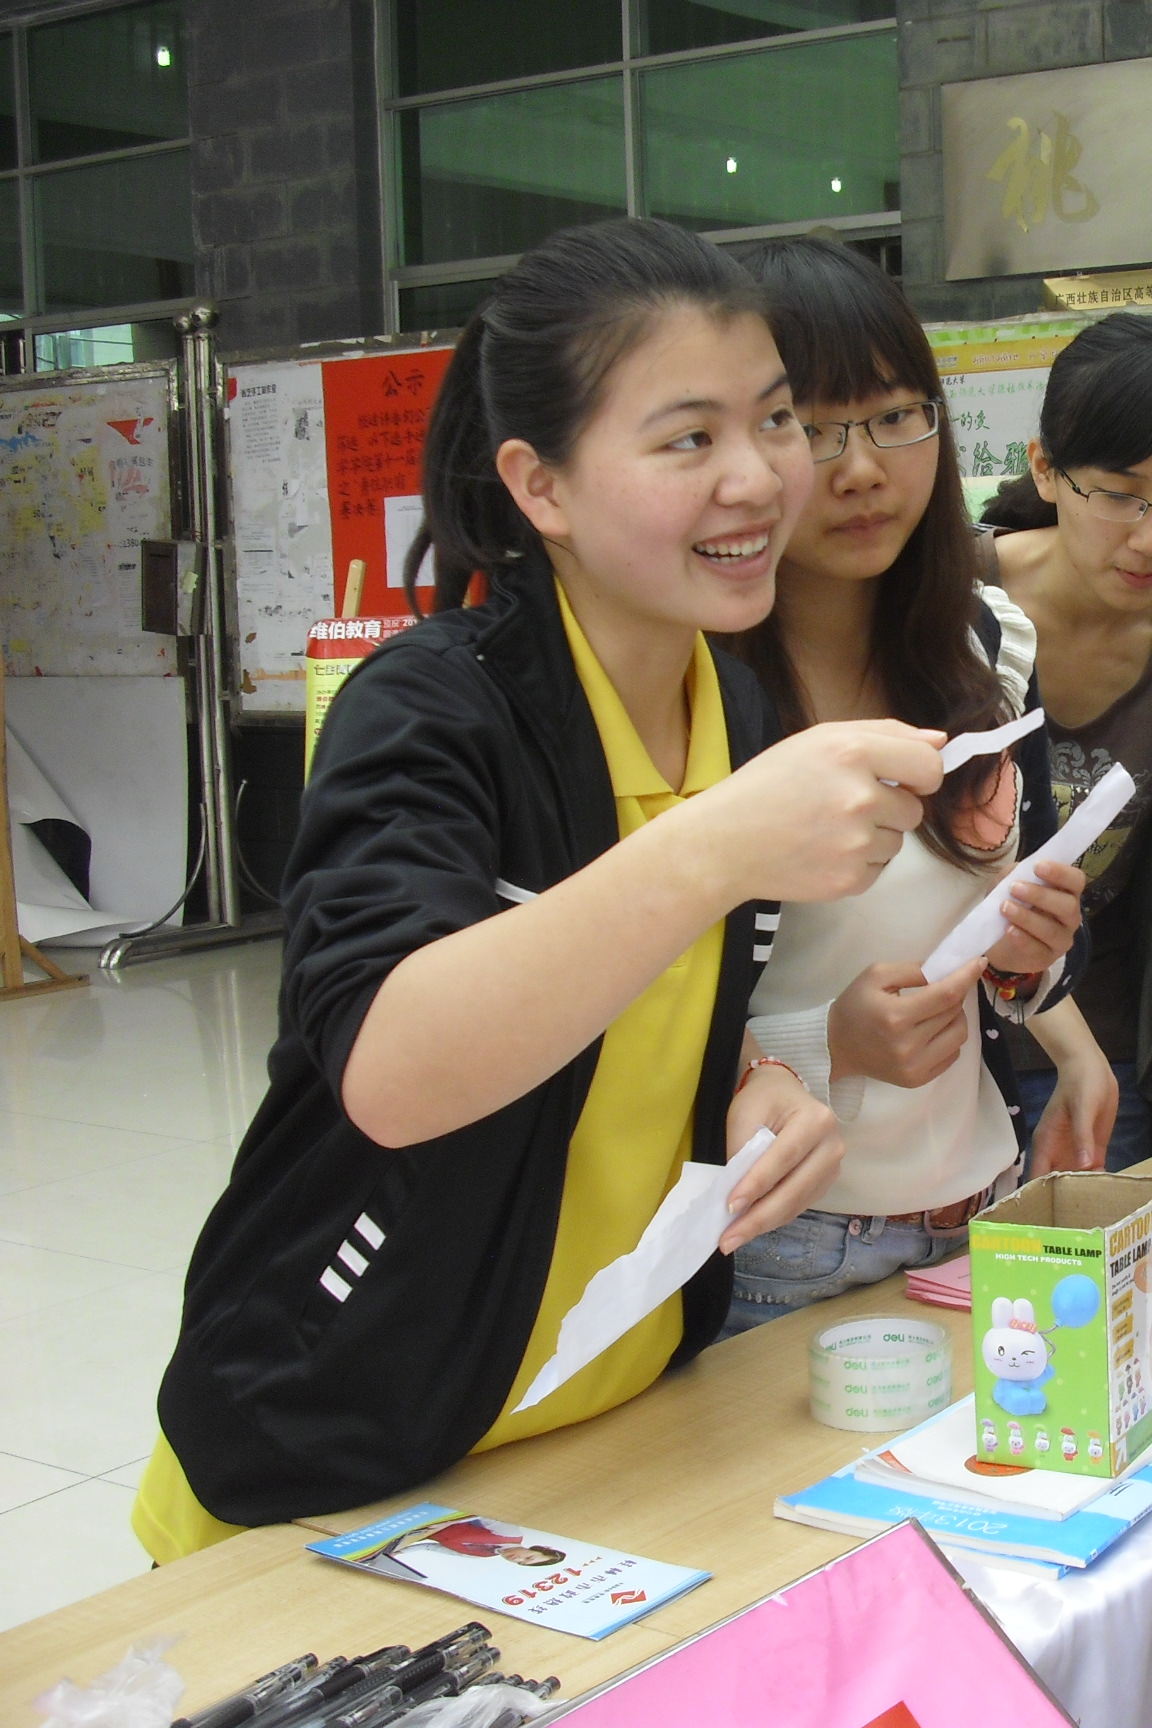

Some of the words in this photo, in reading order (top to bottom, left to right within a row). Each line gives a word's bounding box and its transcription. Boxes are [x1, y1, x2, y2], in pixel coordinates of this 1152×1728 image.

[309, 620, 382, 640] 维伯教育
[1043, 1245, 1073, 1257] TABLE
[1075, 1247, 1102, 1258] LAMP
[995, 1253, 1016, 1261] HIGH
[1040, 1256, 1082, 1266] PRODUCTS
[1110, 1256, 1131, 1278] TABLE
[883, 1333, 904, 1342] deli
[844, 1361, 867, 1370] deli
[844, 1384, 867, 1394] deli
[845, 1408, 868, 1418] deli
[502, 1565, 583, 1607] 12319
